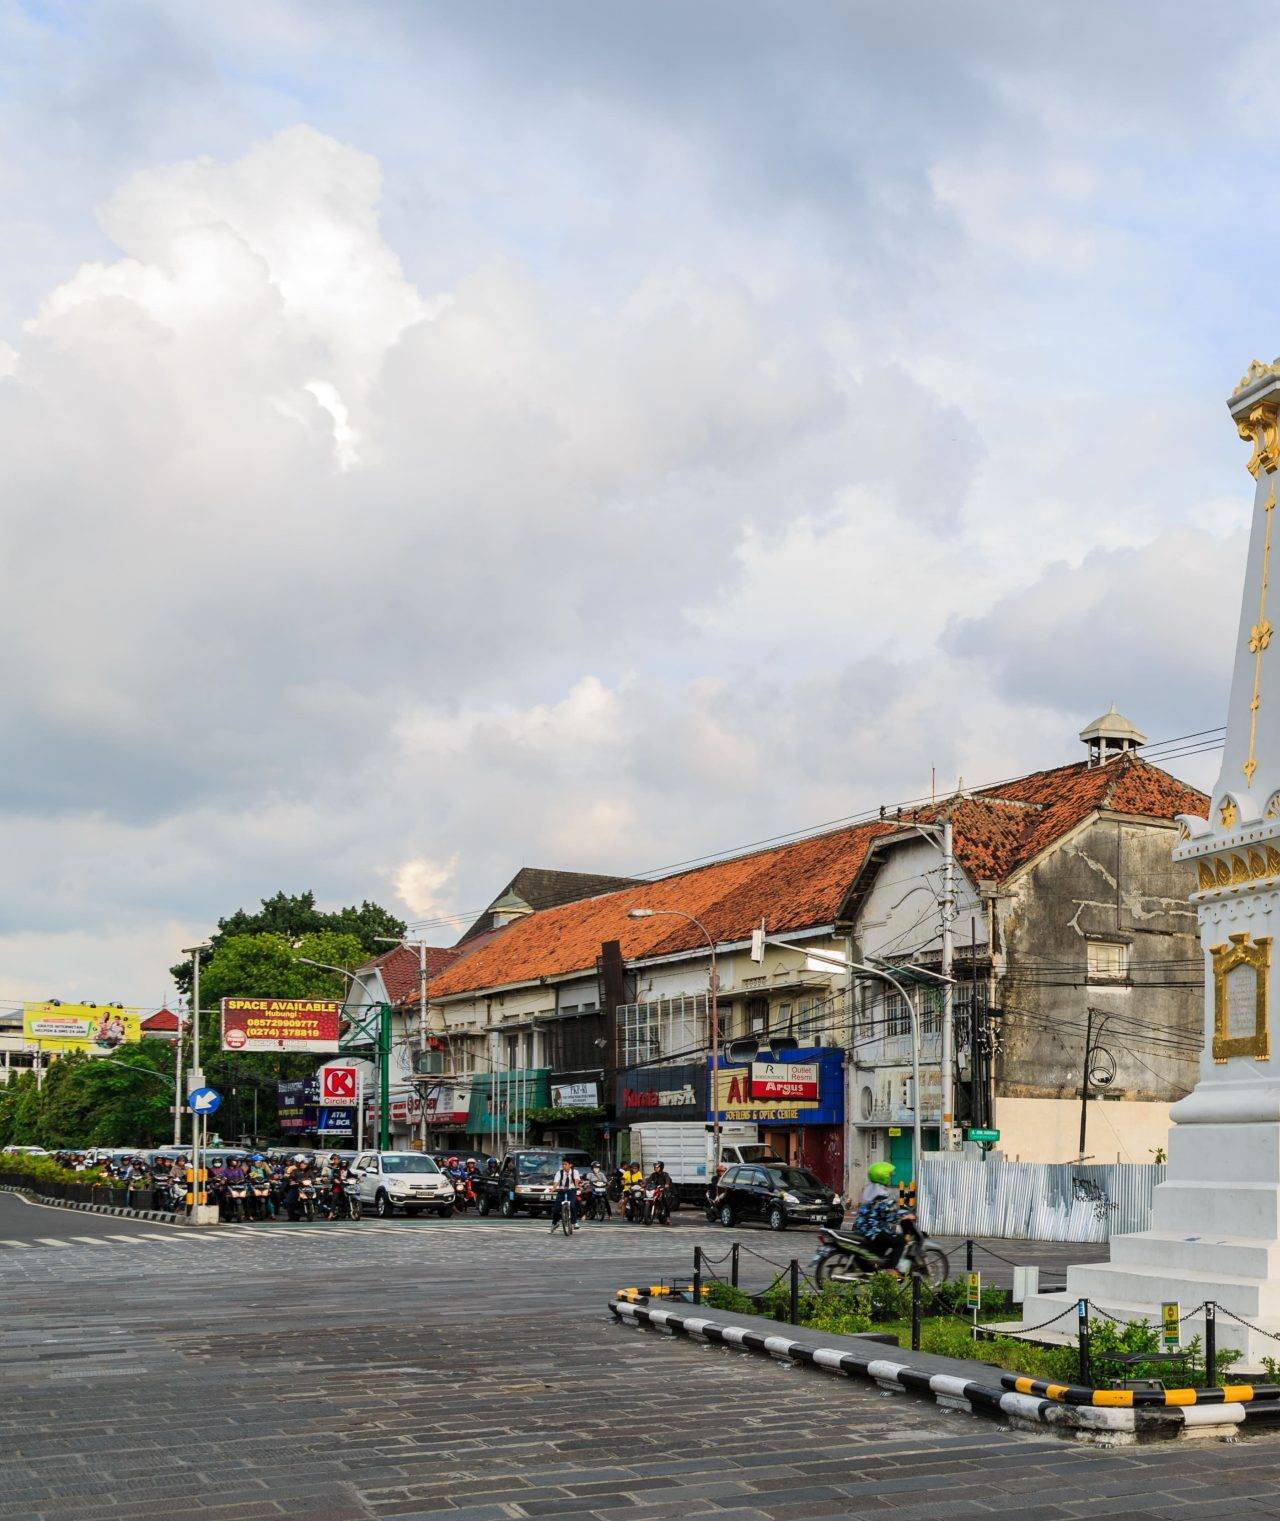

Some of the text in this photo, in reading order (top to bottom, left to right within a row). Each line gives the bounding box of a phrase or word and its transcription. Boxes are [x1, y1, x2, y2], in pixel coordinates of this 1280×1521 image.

[228, 1000, 336, 1012] SPACE AVAILABLE
[265, 1010, 297, 1018] Hubungi
[246, 1029, 279, 1037] (0274)
[791, 1073, 813, 1081] Resmi
[765, 1082, 804, 1095] Argus
[324, 1097, 348, 1105] Circle
[759, 1109, 776, 1120] OPTIC
[777, 1109, 799, 1119] CENTRE
